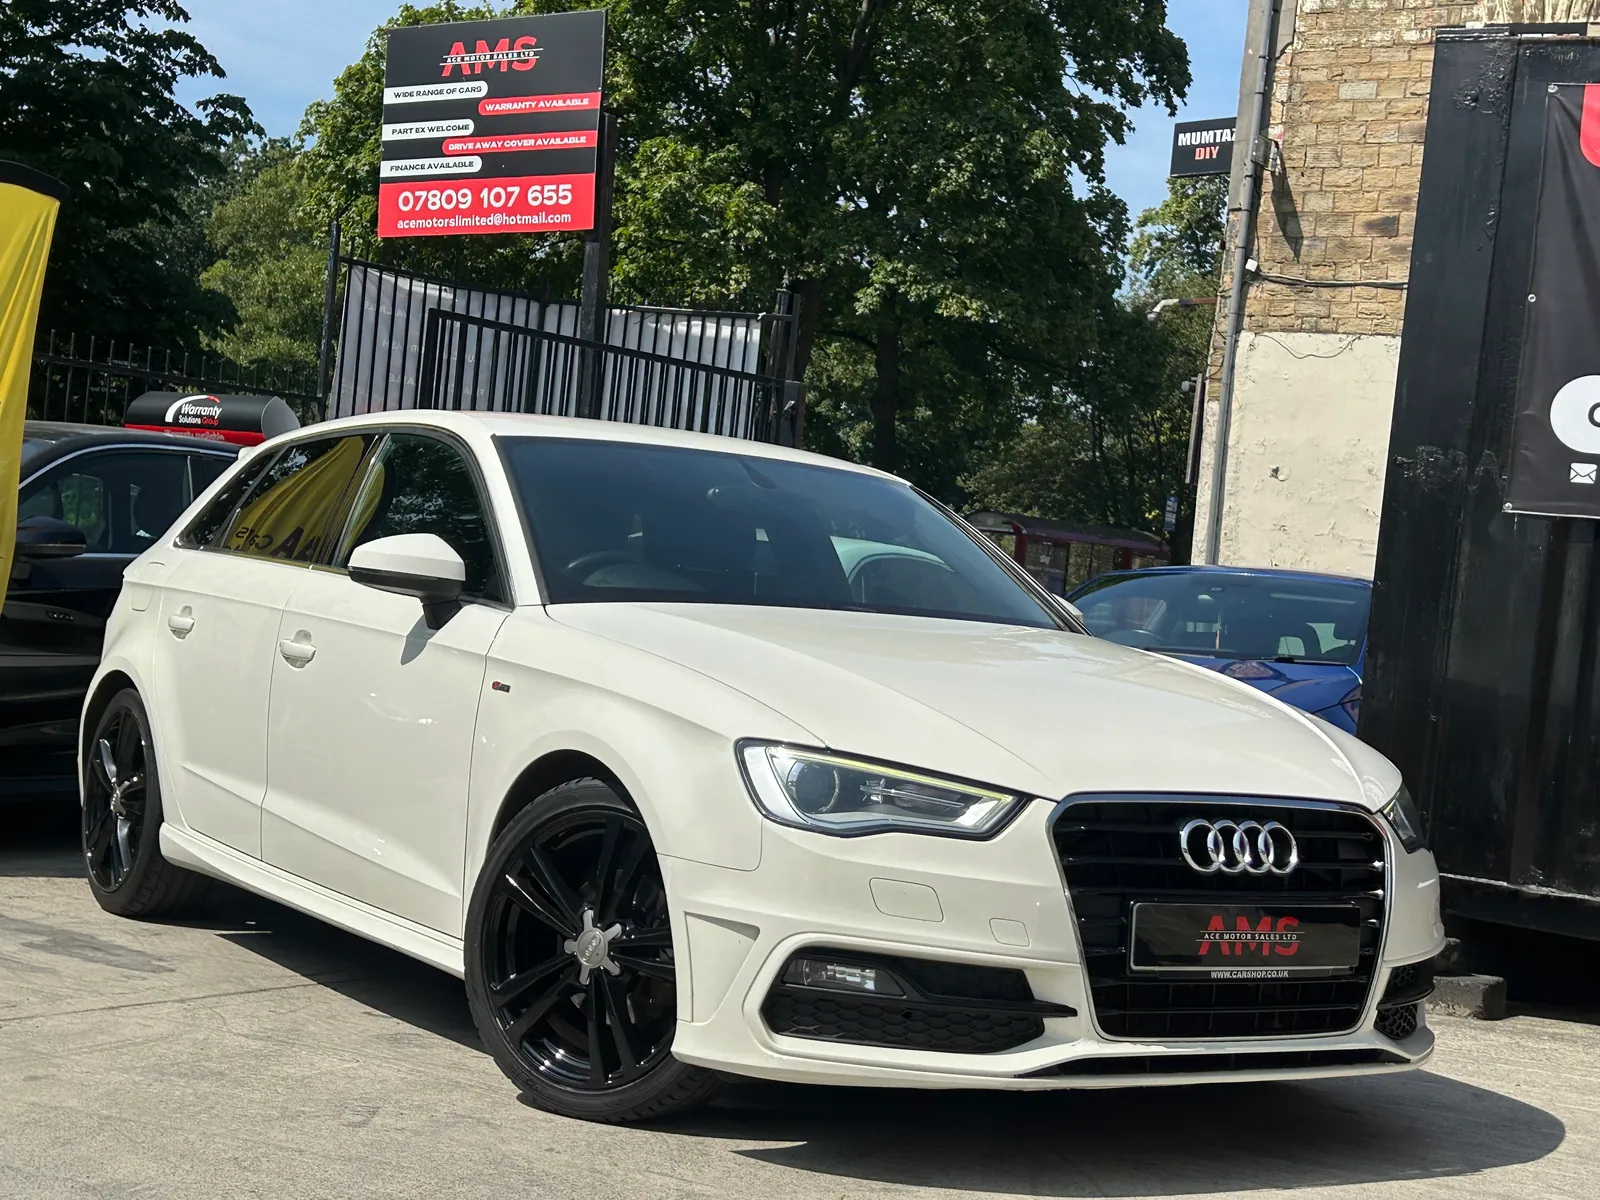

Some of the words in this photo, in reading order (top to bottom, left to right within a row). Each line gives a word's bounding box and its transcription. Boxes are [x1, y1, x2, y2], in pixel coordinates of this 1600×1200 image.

[441, 36, 537, 76] AMS
[464, 54, 490, 62] MOTOR
[393, 91, 415, 99] WIDE
[416, 88, 444, 97] RANGE
[446, 87, 457, 95] OF
[458, 86, 482, 94] CARS
[485, 101, 536, 112] WARRANTY
[537, 98, 590, 108] AVAILABLE
[391, 128, 414, 136] PART
[426, 124, 470, 133] WELCOME
[448, 142, 474, 151] DRIVE
[475, 140, 504, 150] AWAY
[504, 139, 535, 148] COVER
[535, 136, 586, 146] AVAILABLE
[1195, 146, 1219, 160] DIY
[390, 163, 426, 172] FINANCE
[427, 160, 474, 170] AVAILABLE
[397, 188, 472, 212] 07809
[480, 186, 520, 209] 107
[527, 184, 573, 206] 655
[397, 212, 571, 229] acemotorslimited@hotmail.com
[180, 403, 222, 419] Warranty
[178, 415, 201, 424] Solutions
[201, 416, 219, 426] Group
[1198, 915, 1299, 956] AMS
[1210, 970, 1289, 979] WWW.CARSHOP.CO.UK
